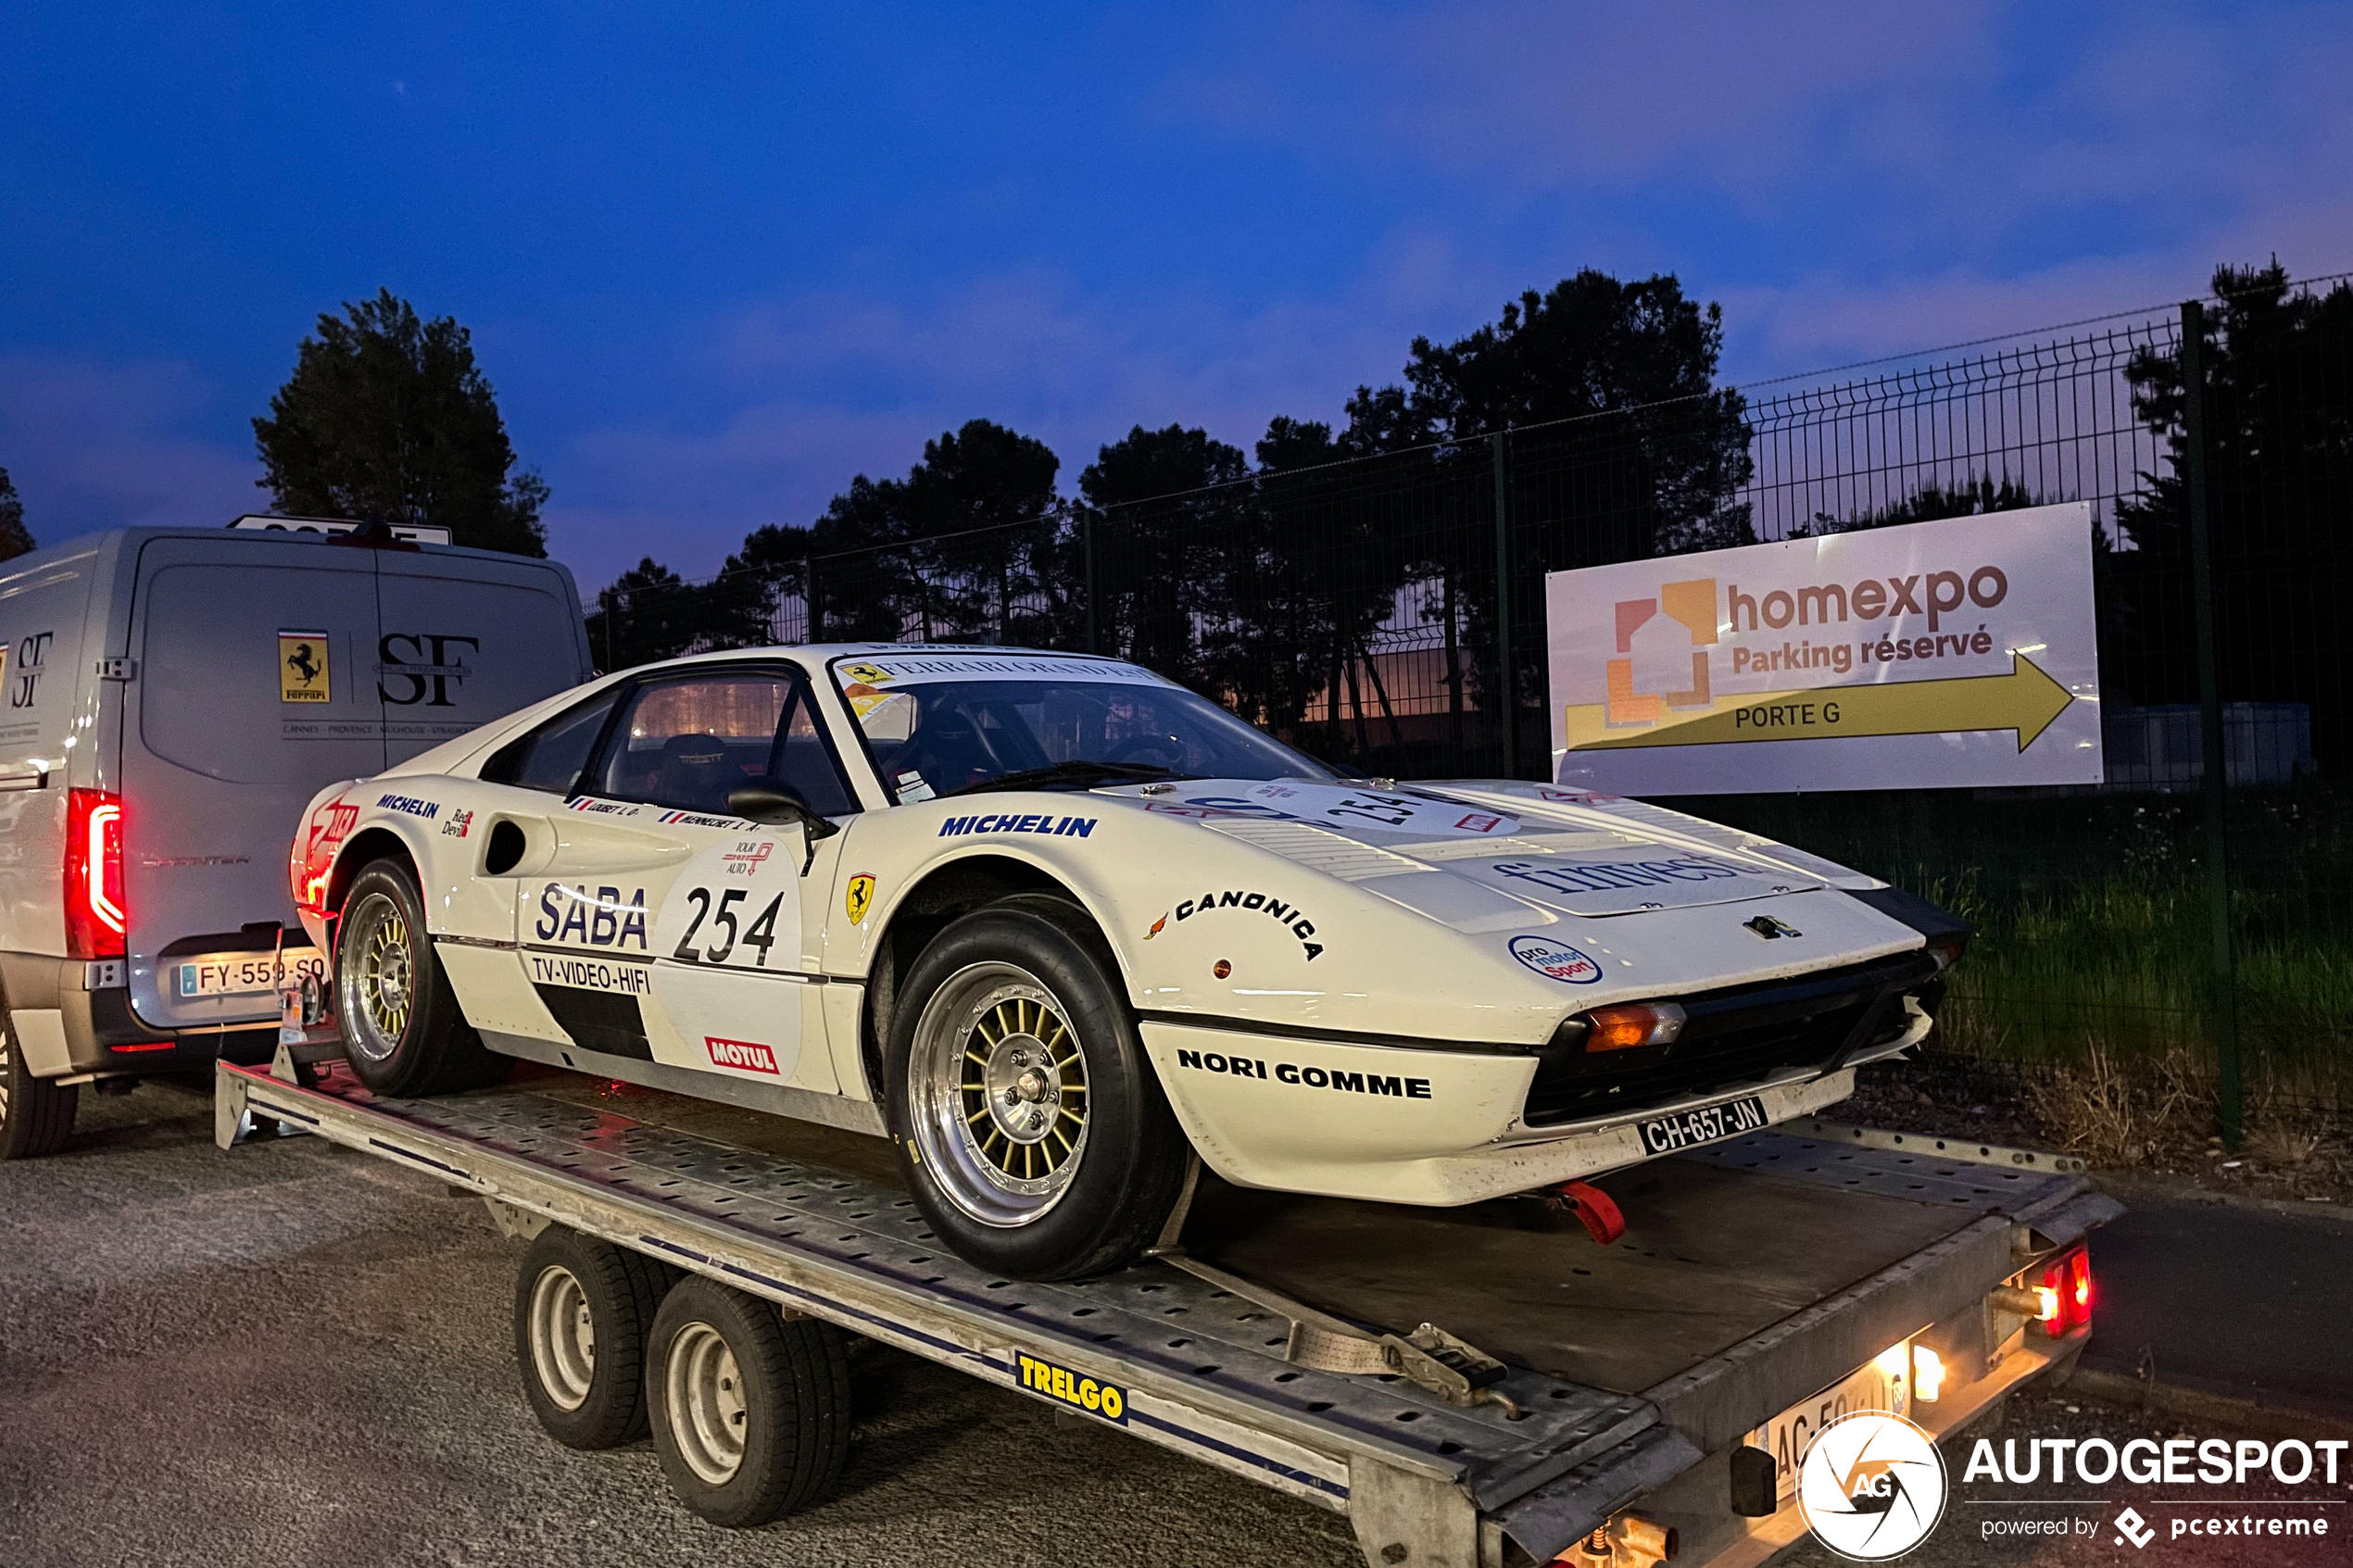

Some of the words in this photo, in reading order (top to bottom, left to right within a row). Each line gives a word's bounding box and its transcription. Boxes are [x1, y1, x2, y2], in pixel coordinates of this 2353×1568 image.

[1728, 565, 2007, 633] homexpo
[1732, 640, 1852, 674] Parking
[1860, 623, 1993, 664] réservé
[12, 631, 54, 709] SF
[378, 633, 479, 707] SF
[877, 660, 1011, 677] FERRARI
[1012, 660, 1108, 676] GRAND
[285, 689, 326, 701] Ferrari
[283, 723, 320, 734] CANNES
[327, 724, 371, 734] PROVENCE
[379, 725, 425, 735] MULHOUSE
[1735, 704, 1816, 729] PORTE
[1822, 701, 1841, 723] G
[376, 794, 441, 820] MICHELIN
[452, 809, 472, 824] Red
[1327, 792, 1423, 826] 254
[441, 821, 466, 838] Devil
[938, 814, 1099, 838] MICHELIN
[736, 842, 757, 853] TOUR
[726, 862, 747, 875] AUTO
[535, 882, 648, 950] SABA
[673, 886, 786, 967] 254
[1176, 891, 1324, 963] CANONICA
[1517, 947, 1550, 962] pro
[1534, 951, 1583, 966] motor
[533, 958, 651, 995] TV-VIDEO-HIFI
[1544, 960, 1595, 978] Sport
[710, 1041, 774, 1070] MOTUL
[1176, 1048, 1268, 1080] NORI
[1275, 1063, 1433, 1099] GOMME
[1646, 1098, 1762, 1152] CH-657-JN
[1019, 1355, 1123, 1419] TRELGO
